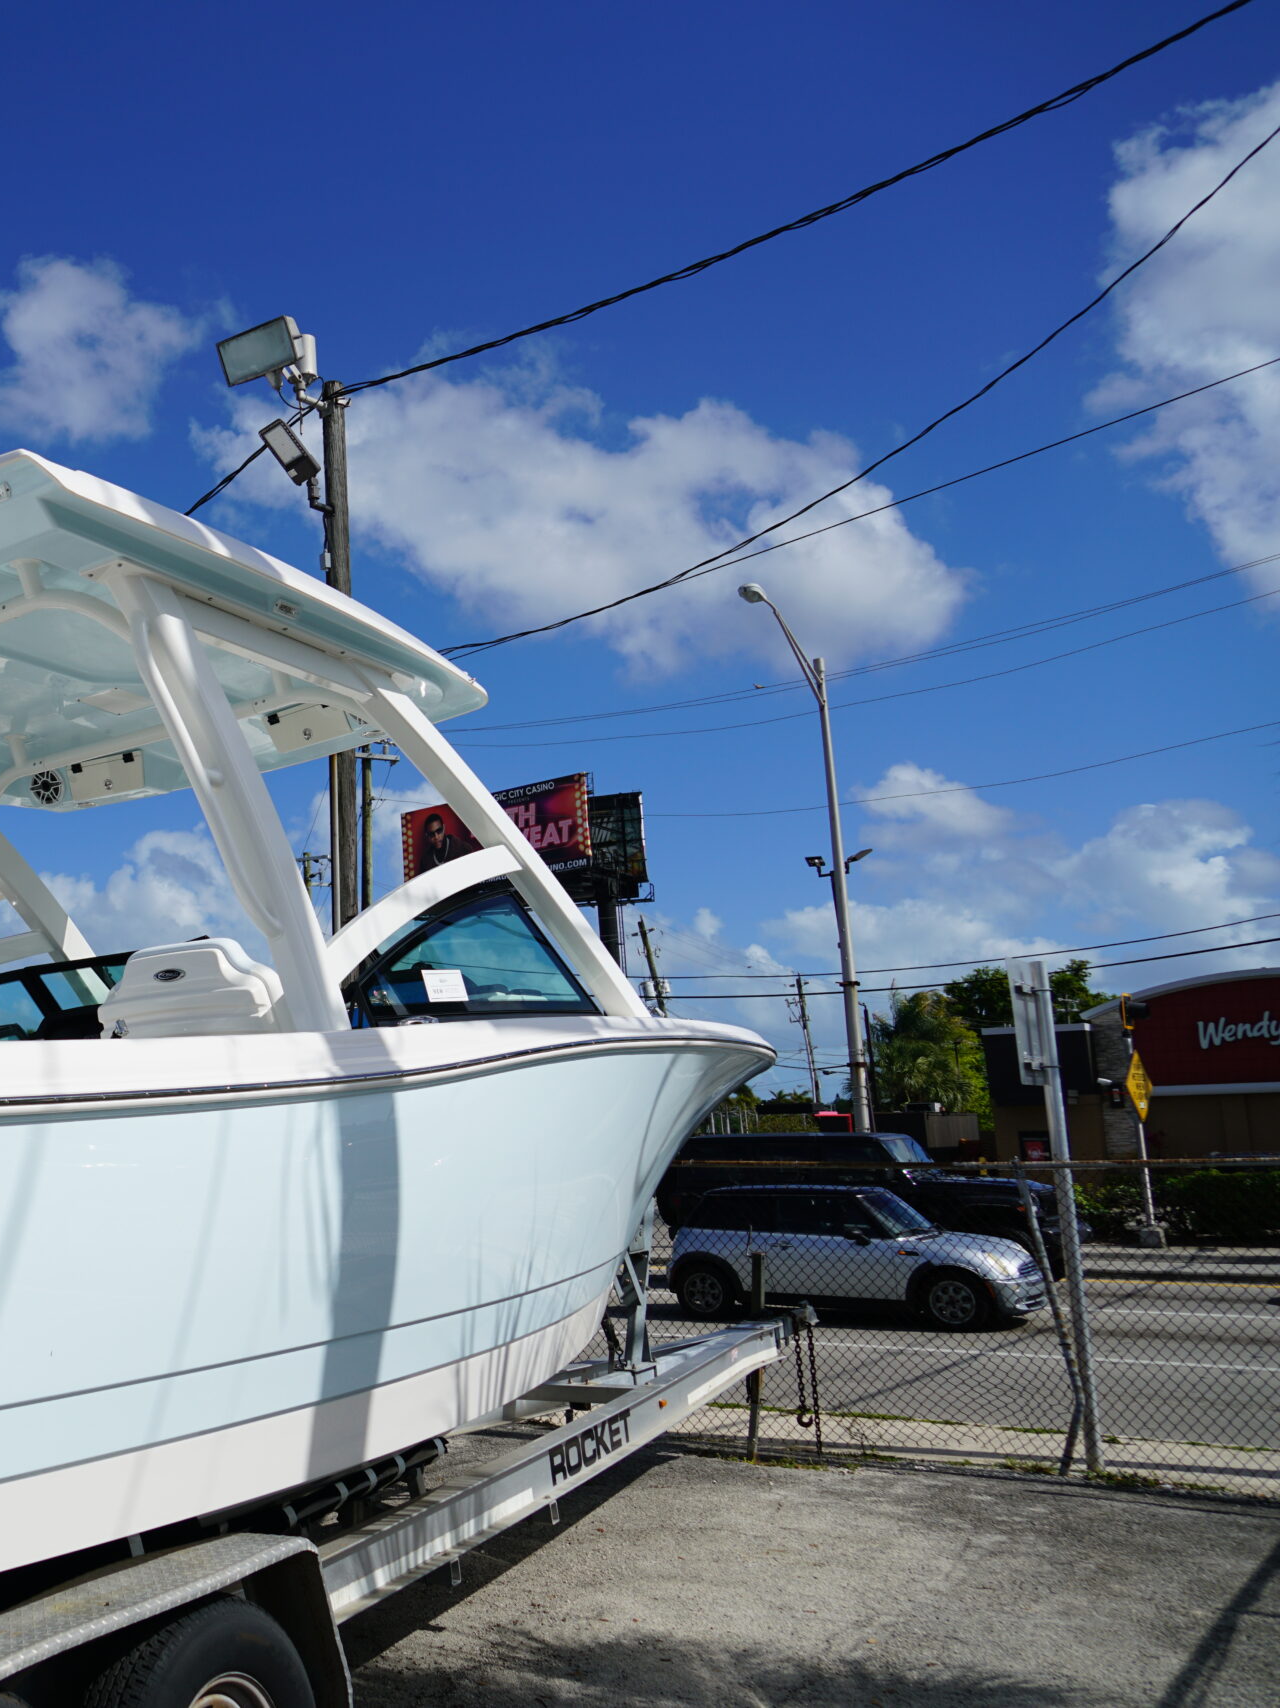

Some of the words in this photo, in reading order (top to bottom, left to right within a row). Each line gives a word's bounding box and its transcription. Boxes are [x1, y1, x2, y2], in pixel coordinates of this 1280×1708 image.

[508, 788, 524, 799] CITY
[525, 781, 555, 795] CASINO
[548, 1407, 631, 1487] ROCKET
